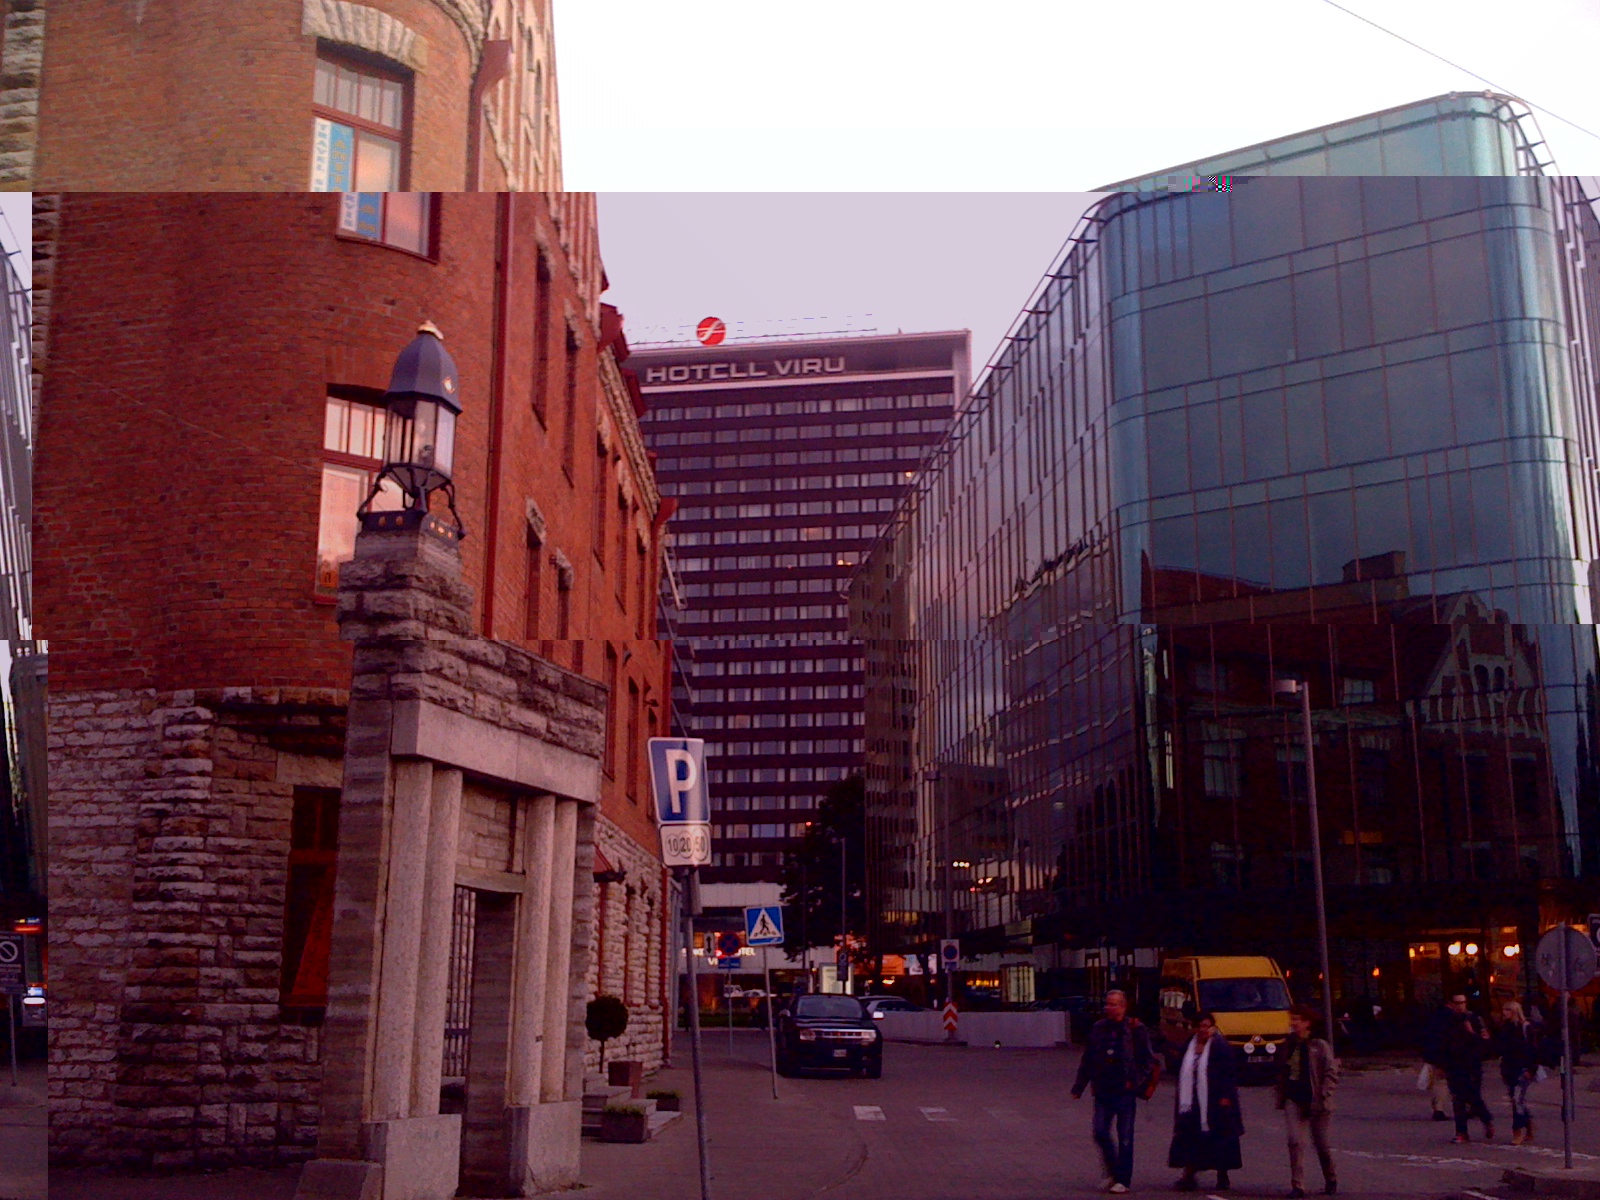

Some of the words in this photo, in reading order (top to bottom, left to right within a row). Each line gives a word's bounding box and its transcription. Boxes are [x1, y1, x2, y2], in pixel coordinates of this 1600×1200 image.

[646, 362, 768, 383] HOTELL
[774, 356, 845, 376] VIRU
[665, 748, 697, 814] P
[668, 838, 678, 852] 10
